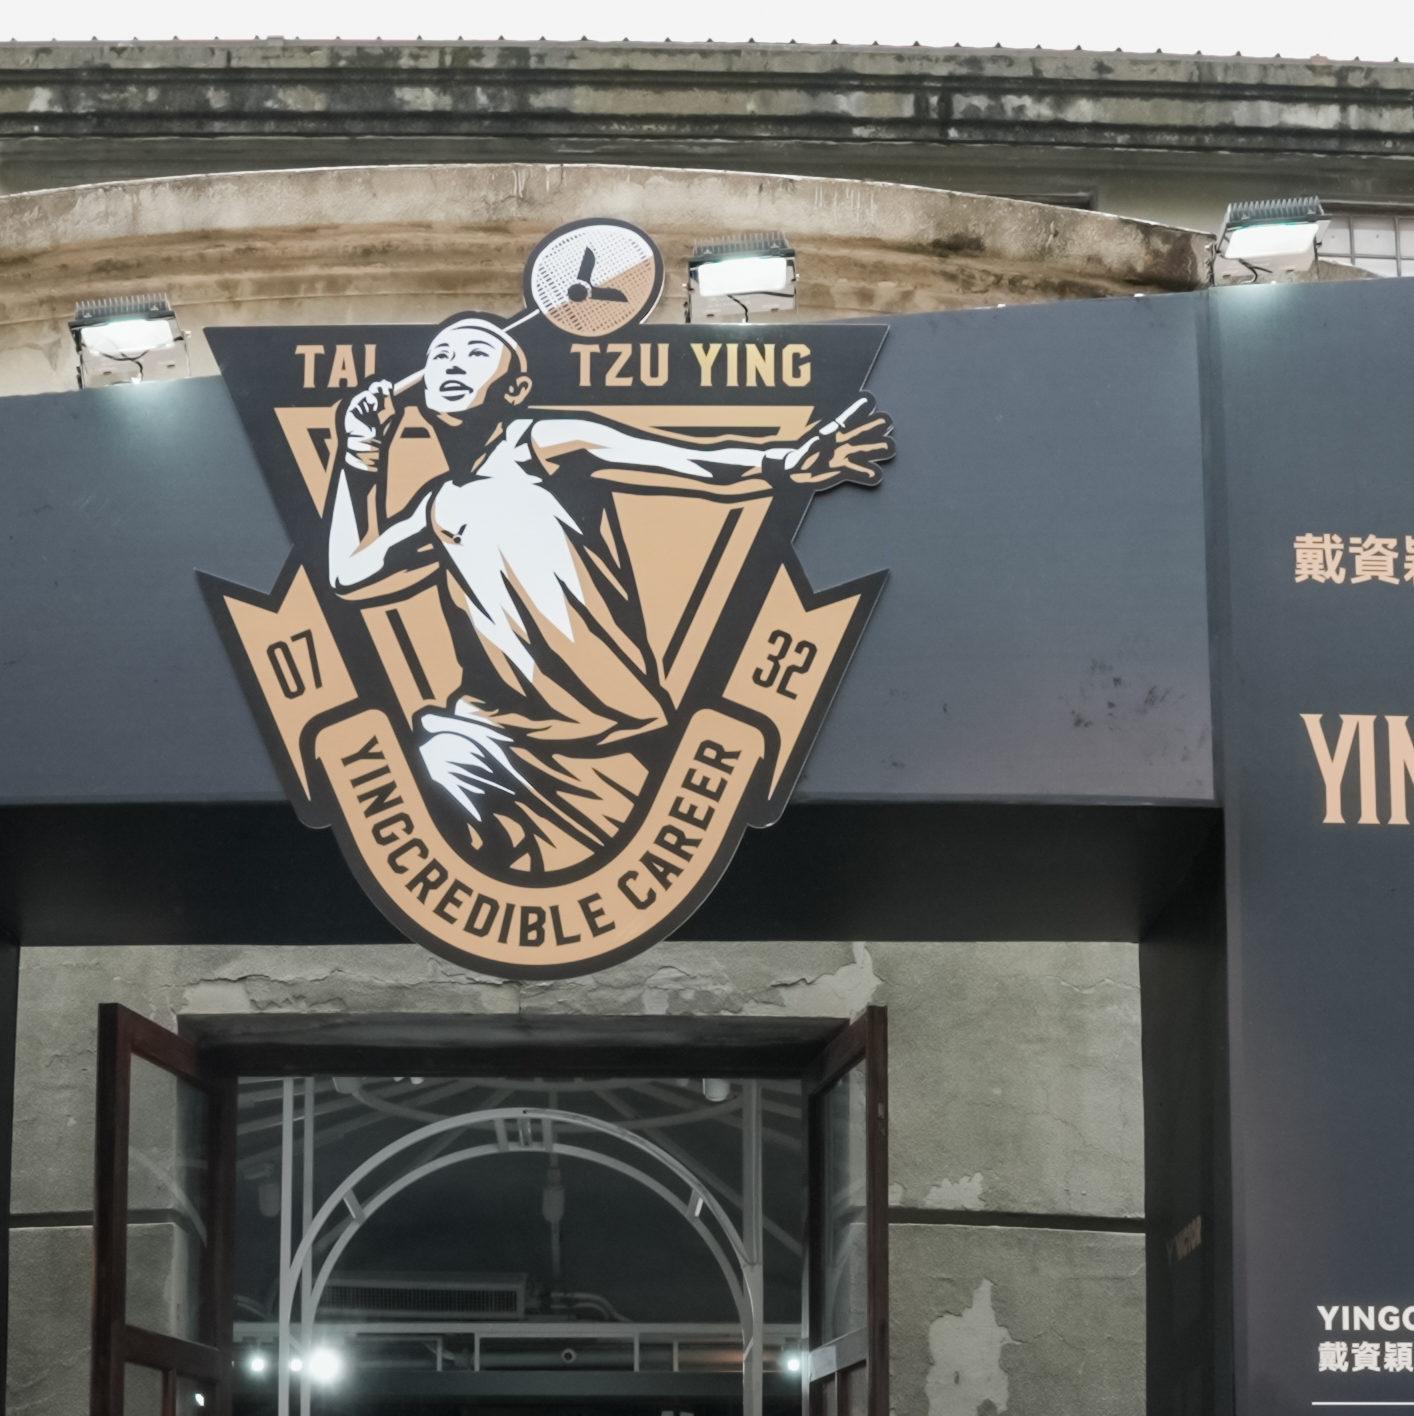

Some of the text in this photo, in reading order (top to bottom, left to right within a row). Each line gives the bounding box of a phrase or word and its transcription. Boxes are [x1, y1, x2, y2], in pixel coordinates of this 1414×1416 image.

[294, 343, 812, 388] TAI TZU YING
[266, 629, 324, 699] 07
[752, 629, 818, 699] 32
[341, 735, 742, 947] YINGCREDIBLE CAREER
